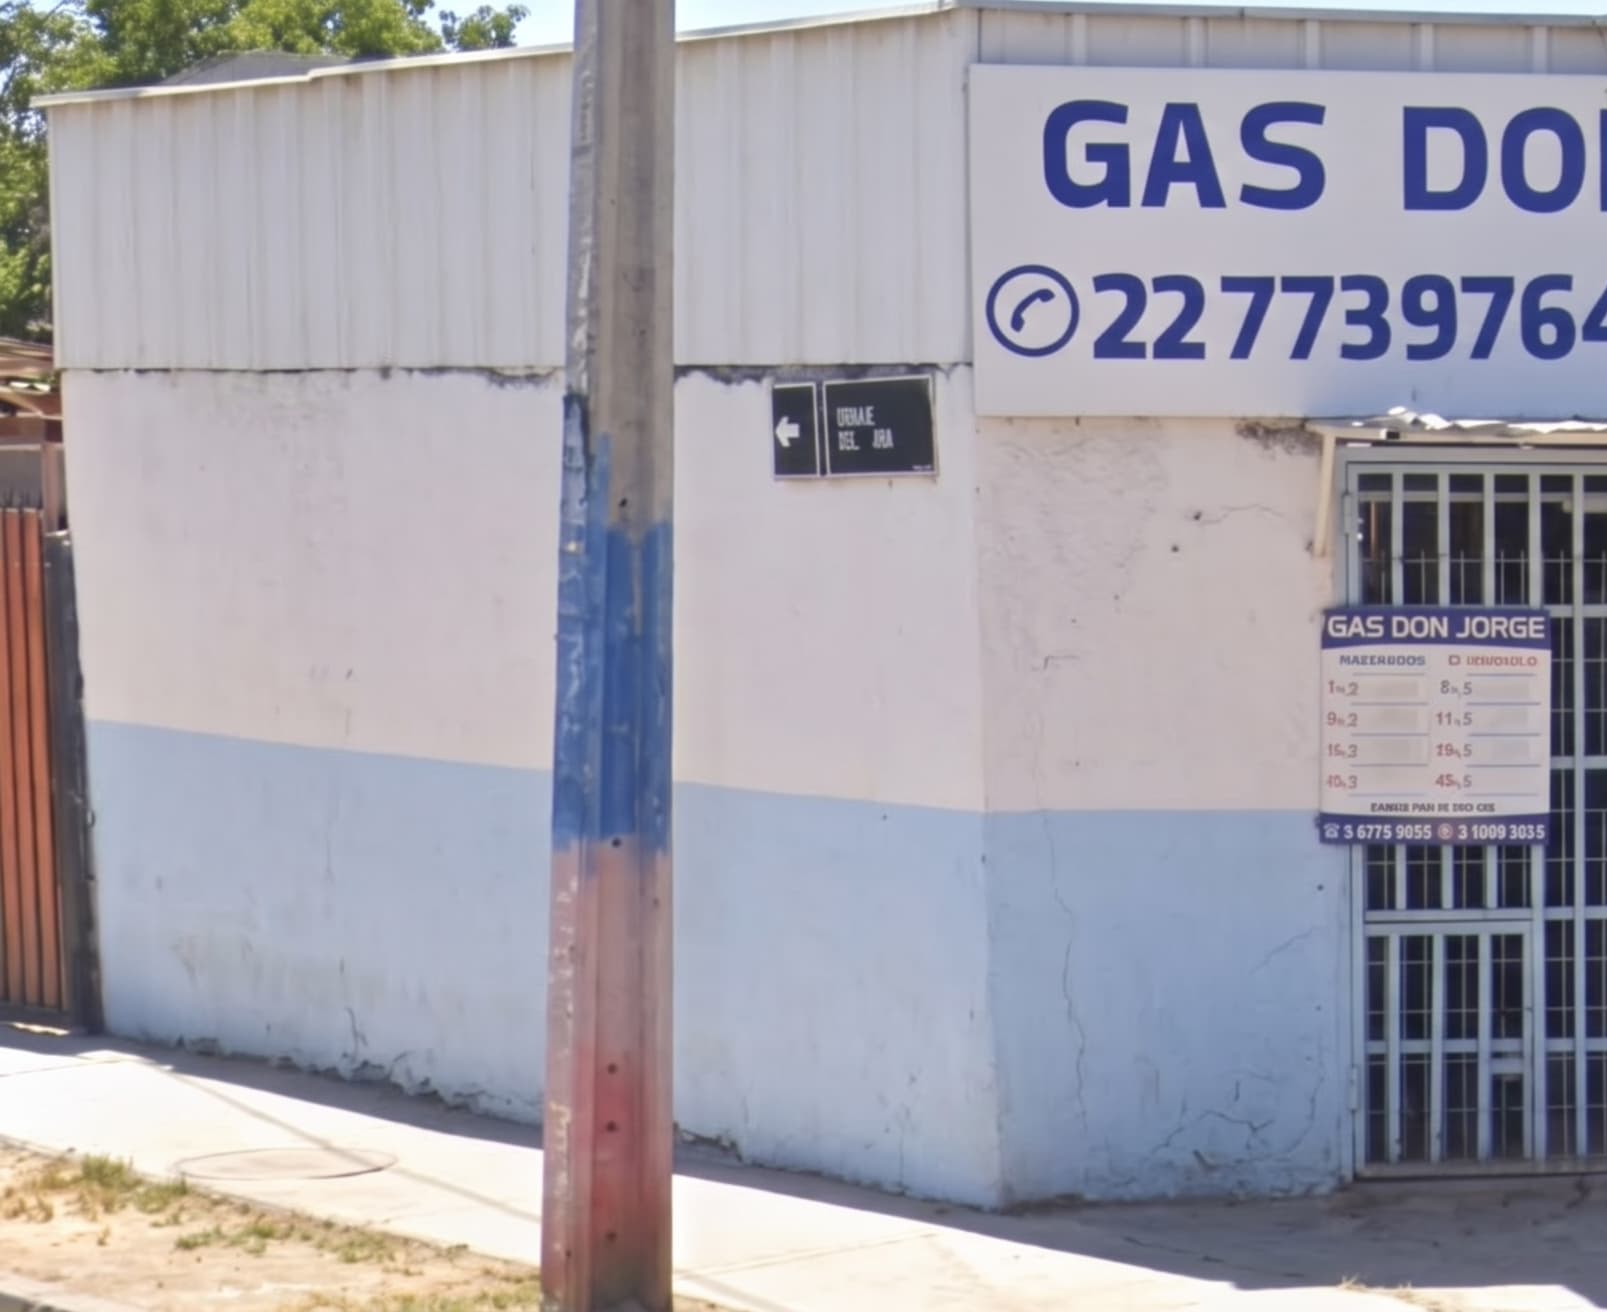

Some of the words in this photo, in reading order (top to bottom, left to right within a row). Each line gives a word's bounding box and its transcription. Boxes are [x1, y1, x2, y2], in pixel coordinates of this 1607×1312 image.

[1043, 102, 1325, 210] GAS
[1327, 616, 1384, 638] GAS
[1392, 617, 1448, 638] DON
[1456, 617, 1545, 639] JORGE
